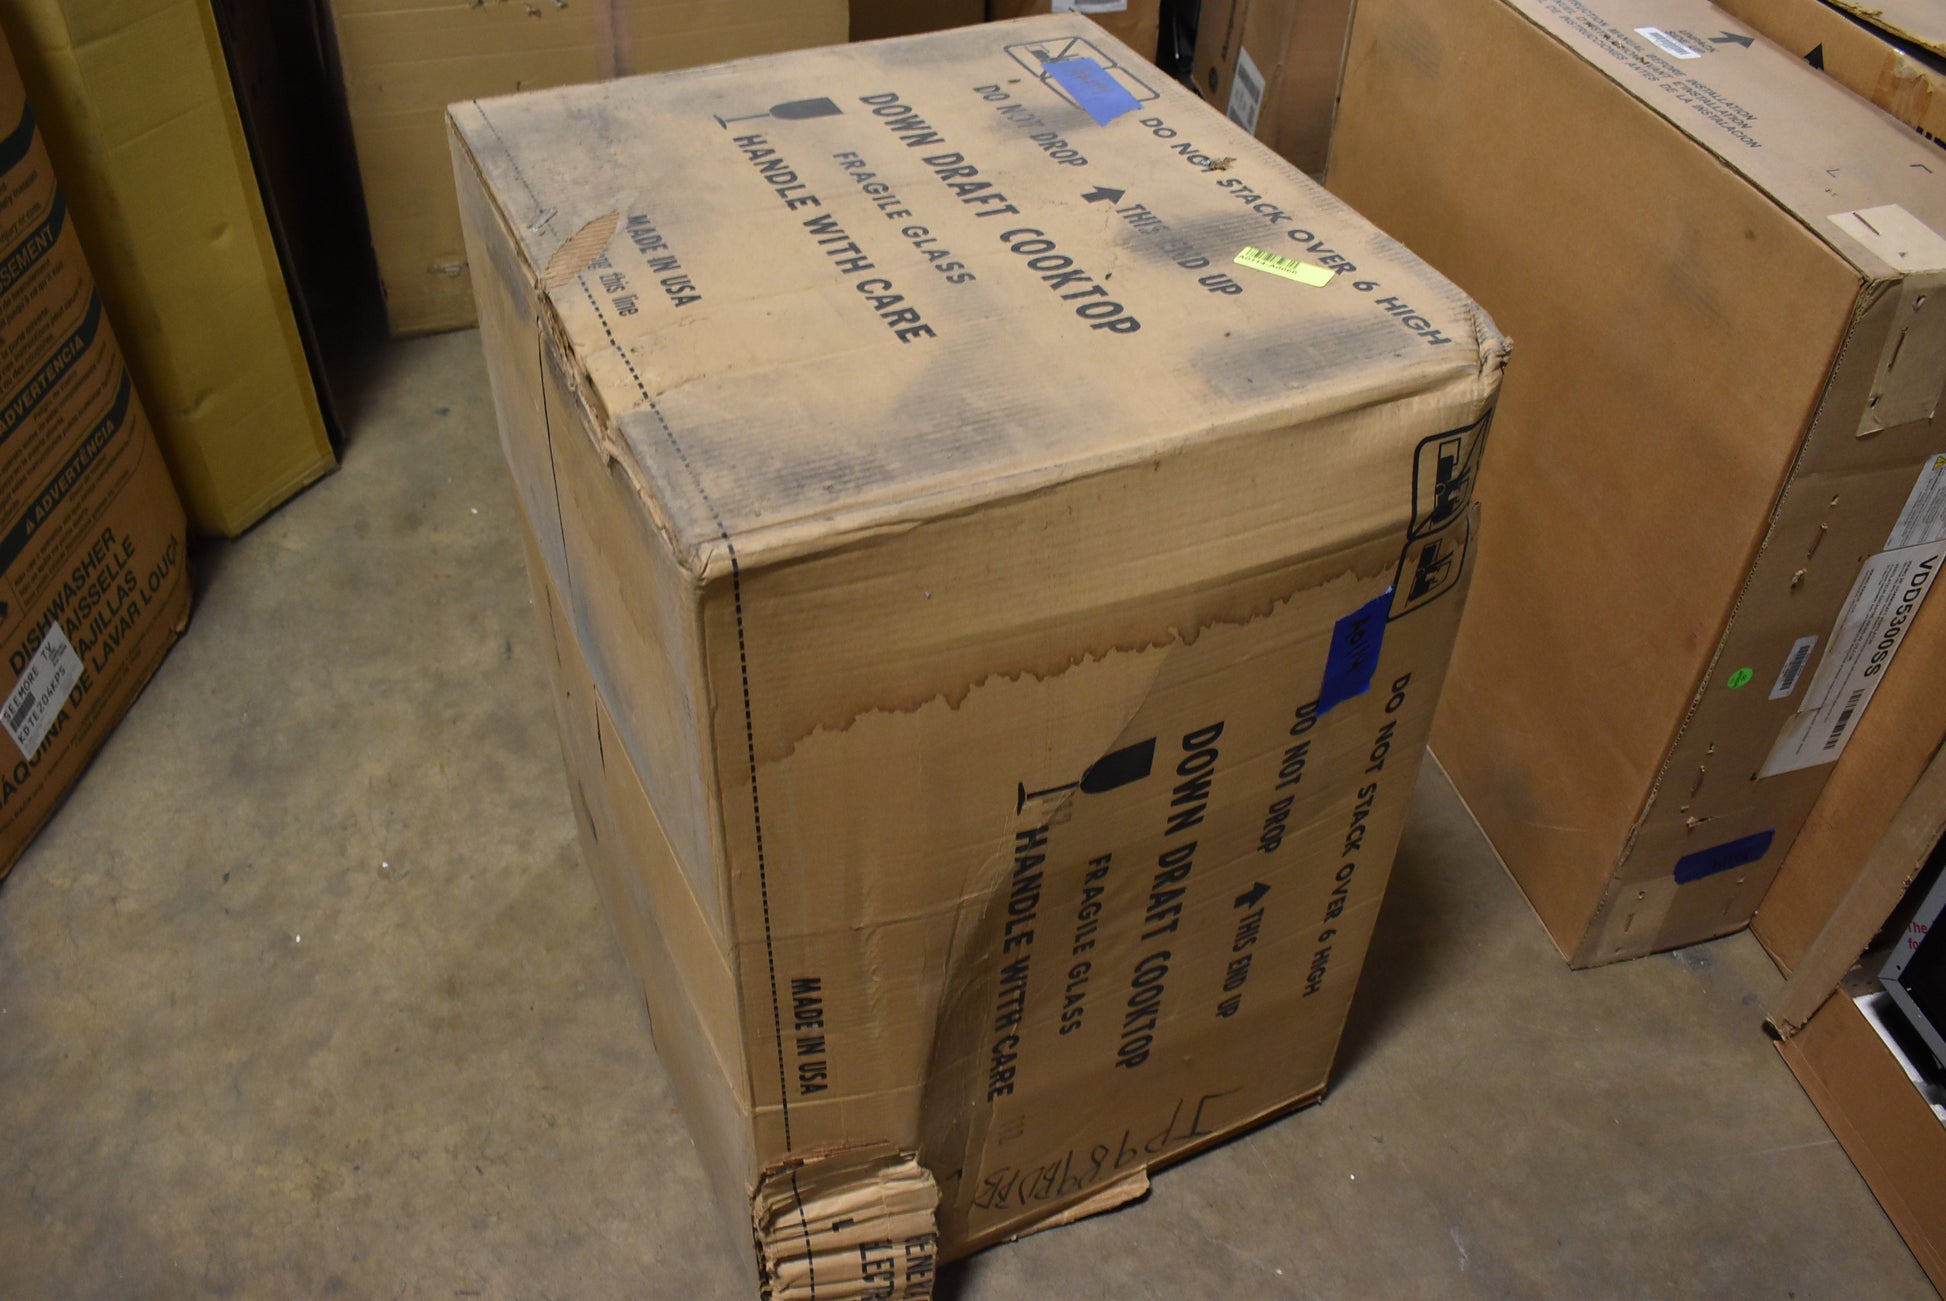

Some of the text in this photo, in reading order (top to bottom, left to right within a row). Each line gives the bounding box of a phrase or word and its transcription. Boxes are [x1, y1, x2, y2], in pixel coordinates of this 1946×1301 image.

[972, 83, 1010, 102] DO
[1029, 131, 1088, 168] DROP
[1684, 79, 1758, 121] INSTALLATION
[1691, 104, 1762, 148] INSTALACION
[626, 214, 702, 308] MADE IN USA
[732, 134, 938, 344] HANDLE WITH CARE
[832, 151, 976, 284] FRAGILE GLASS
[858, 92, 1141, 335] DOWN DRAFT COOKTOP
[1116, 203, 1170, 236] THIS
[1198, 273, 1243, 296] UP
[1139, 117, 1177, 139] DO
[1216, 178, 1293, 225] STACK
[1287, 228, 1357, 276] OVER
[1352, 280, 1380, 292] 6
[1374, 296, 1452, 346] HIGH
[600, 271, 629, 294] this
[612, 294, 639, 317] line
[9, 526, 117, 676] DISHWASHER
[61, 536, 136, 642] AISSELLE
[75, 570, 138, 662] AJILLAS
[1864, 554, 1938, 678] VDD5300SS
[0, 708, 71, 808] ÁQUINA
[69, 669, 94, 710] DE
[92, 600, 141, 674] LAVAR
[140, 532, 179, 607] LOUÇA
[3, 665, 40, 722] SEEMORE
[1257, 700, 1319, 854] DO NOT DROP
[1302, 671, 1412, 999] DO NOT STACK OVER 6 HIGH
[1003, 824, 1049, 954] HANDLE
[1059, 852, 1112, 1036] FRAGILE GLASS
[1116, 720, 1224, 1069] DOWN DRAFT COOKTOP
[995, 955, 1031, 1033] WITH
[1216, 906, 1264, 1019] THIS END UP
[791, 977, 828, 1096] MADE IN USA
[987, 1034, 1020, 1103] CARE
